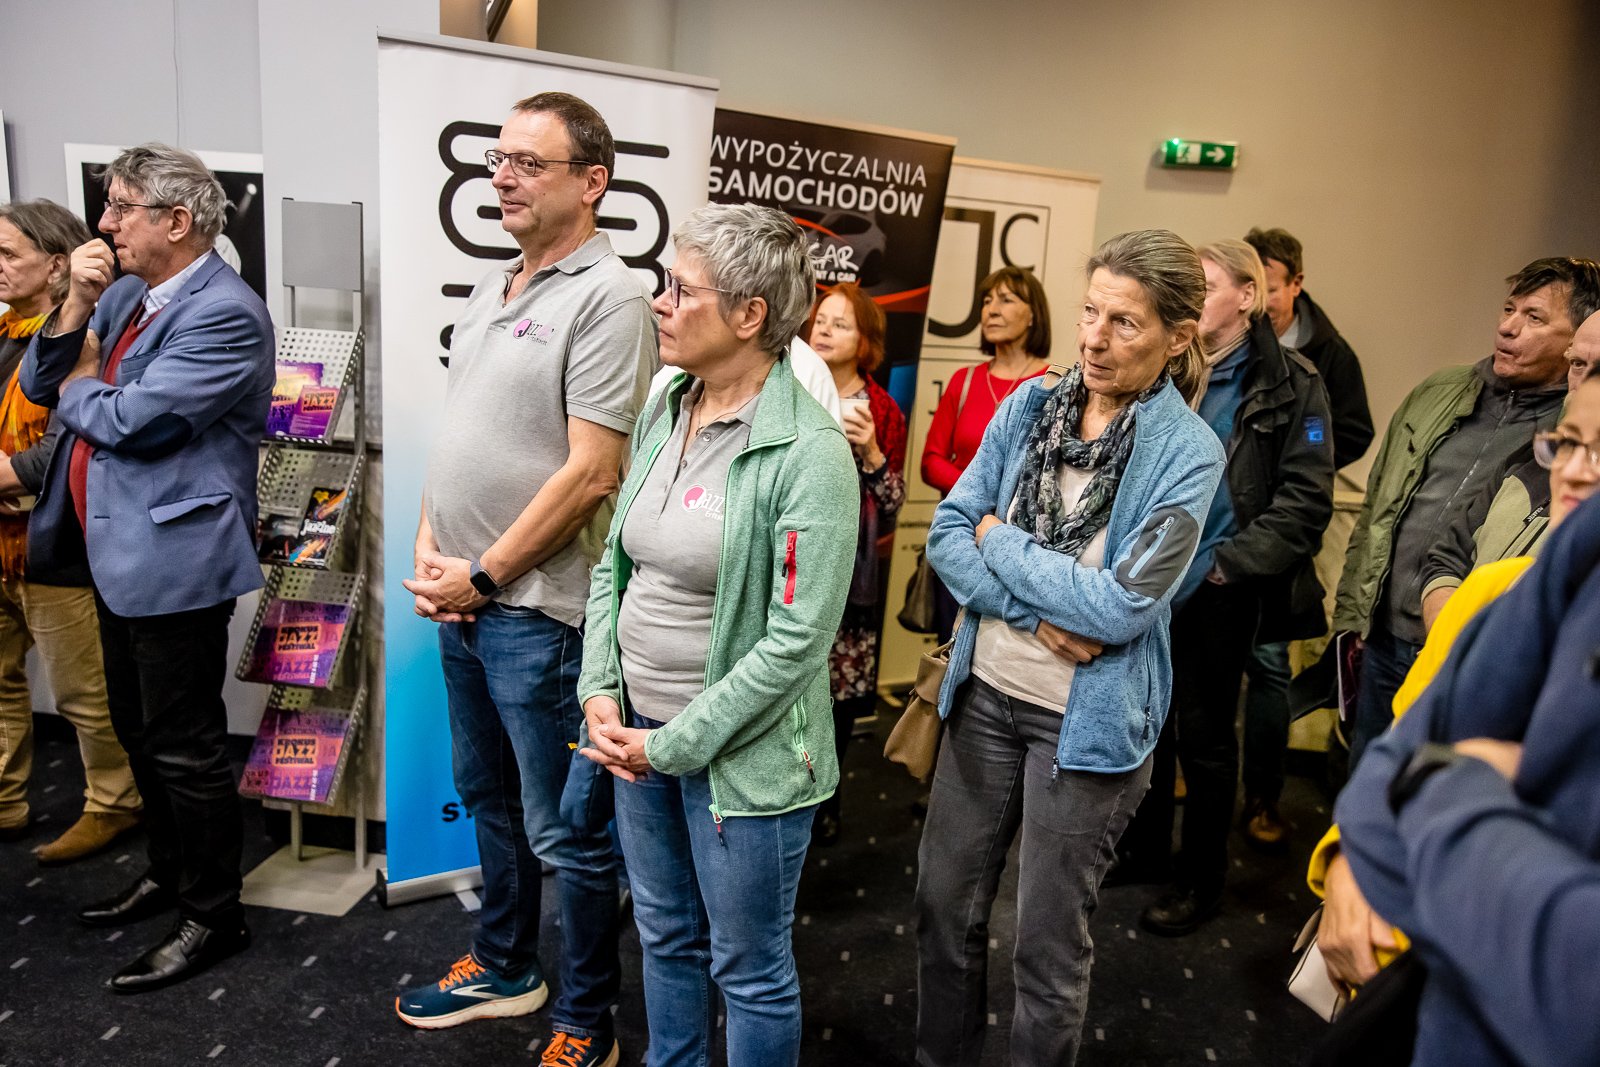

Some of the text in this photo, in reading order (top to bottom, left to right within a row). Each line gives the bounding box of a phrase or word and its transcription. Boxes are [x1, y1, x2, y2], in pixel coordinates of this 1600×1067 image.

[710, 134, 927, 188] WYPOŻYCZALNIA
[708, 165, 924, 218] SAMOCHODÓW
[279, 632, 319, 645] JAZZ
[276, 744, 316, 758] JAZZ
